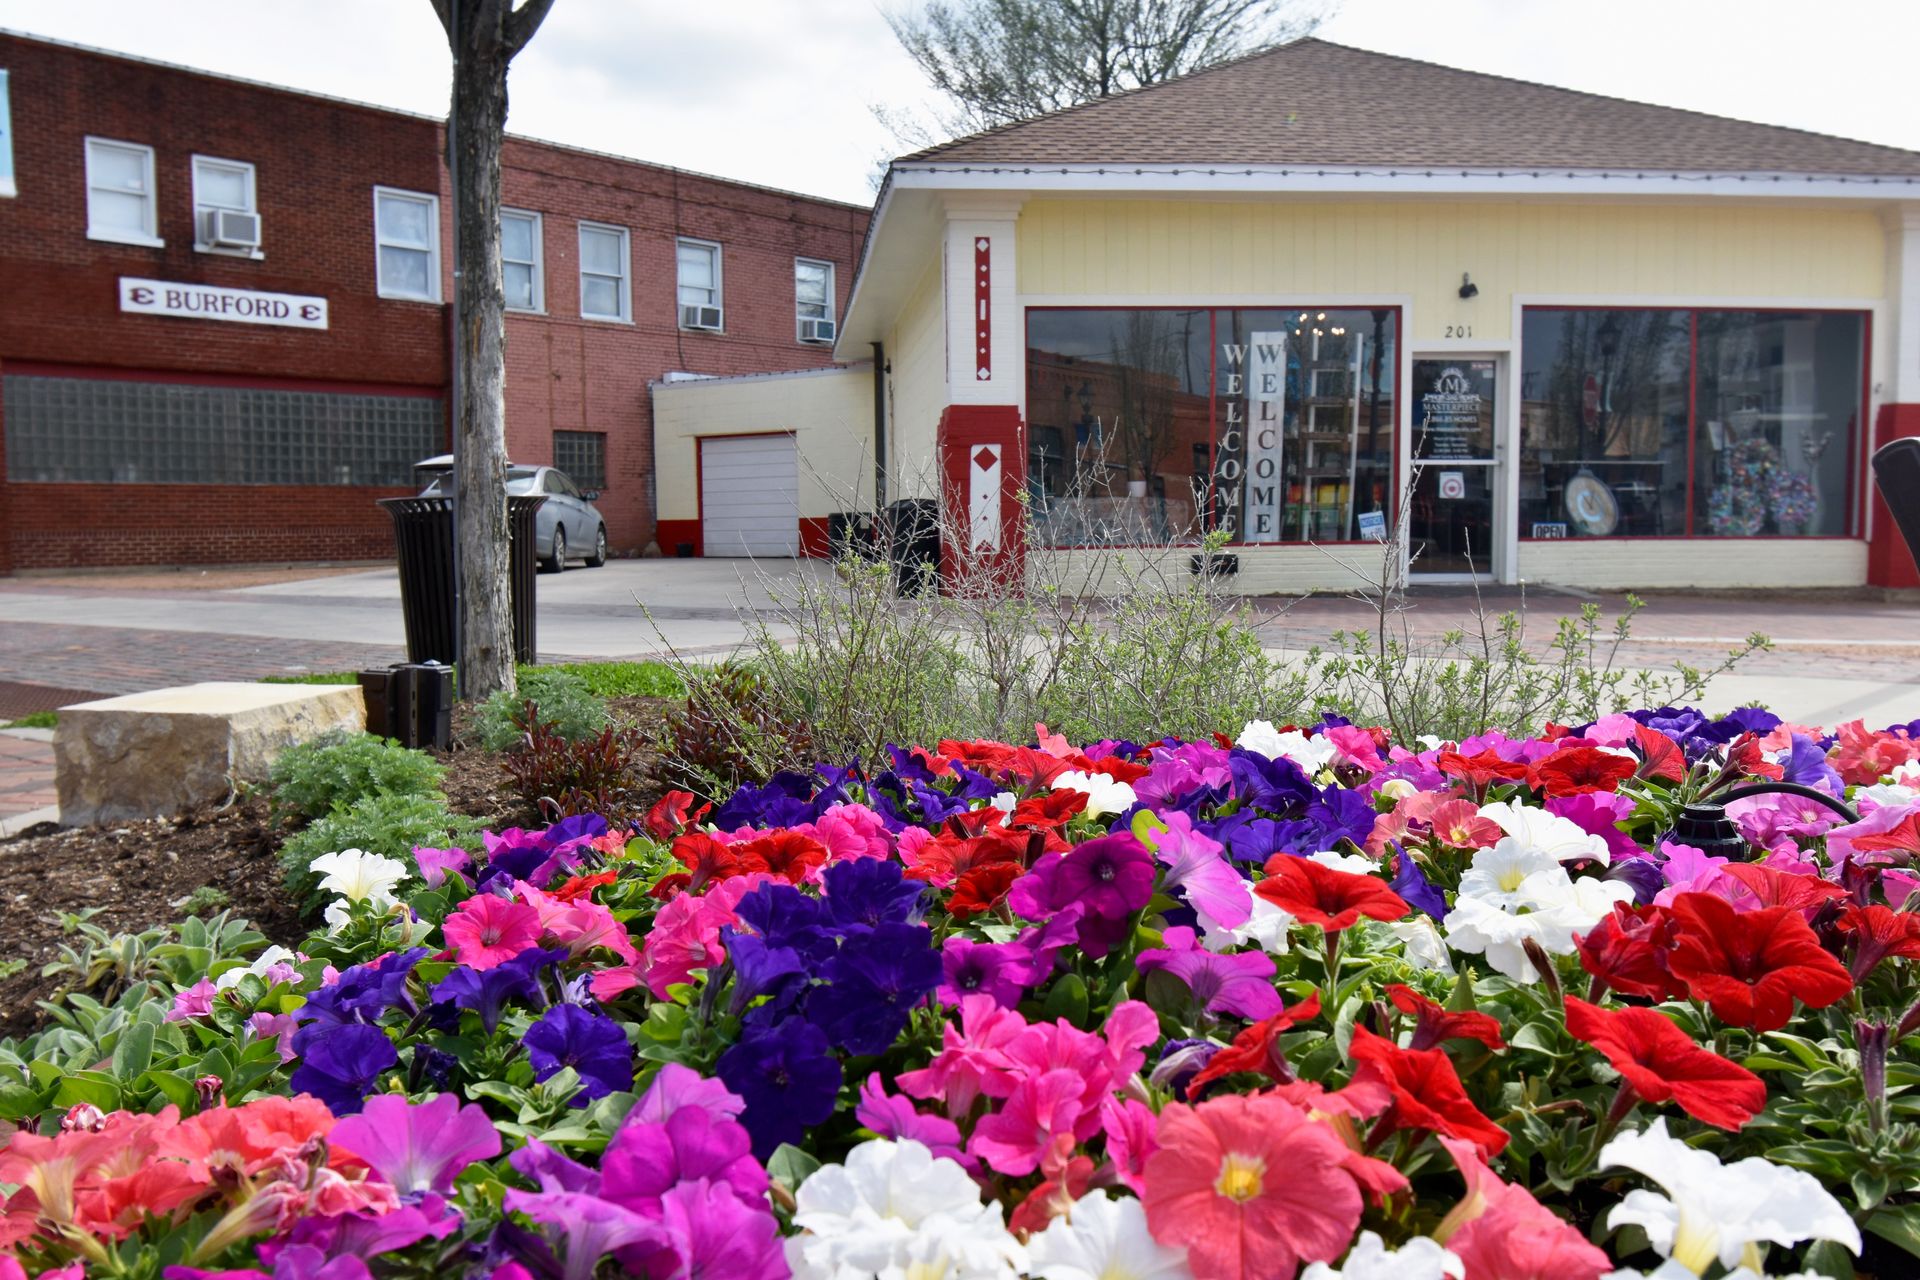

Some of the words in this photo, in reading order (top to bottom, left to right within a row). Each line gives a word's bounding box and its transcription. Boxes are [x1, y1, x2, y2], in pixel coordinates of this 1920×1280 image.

[165, 289, 290, 319] BURFORD
[1444, 325, 1472, 339] 201
[1423, 403, 1480, 411] MASTERPIECE
[1216, 343, 1249, 535] WELCOME
[1251, 343, 1282, 534] WELCOME
[1535, 525, 1565, 538] OPEN
